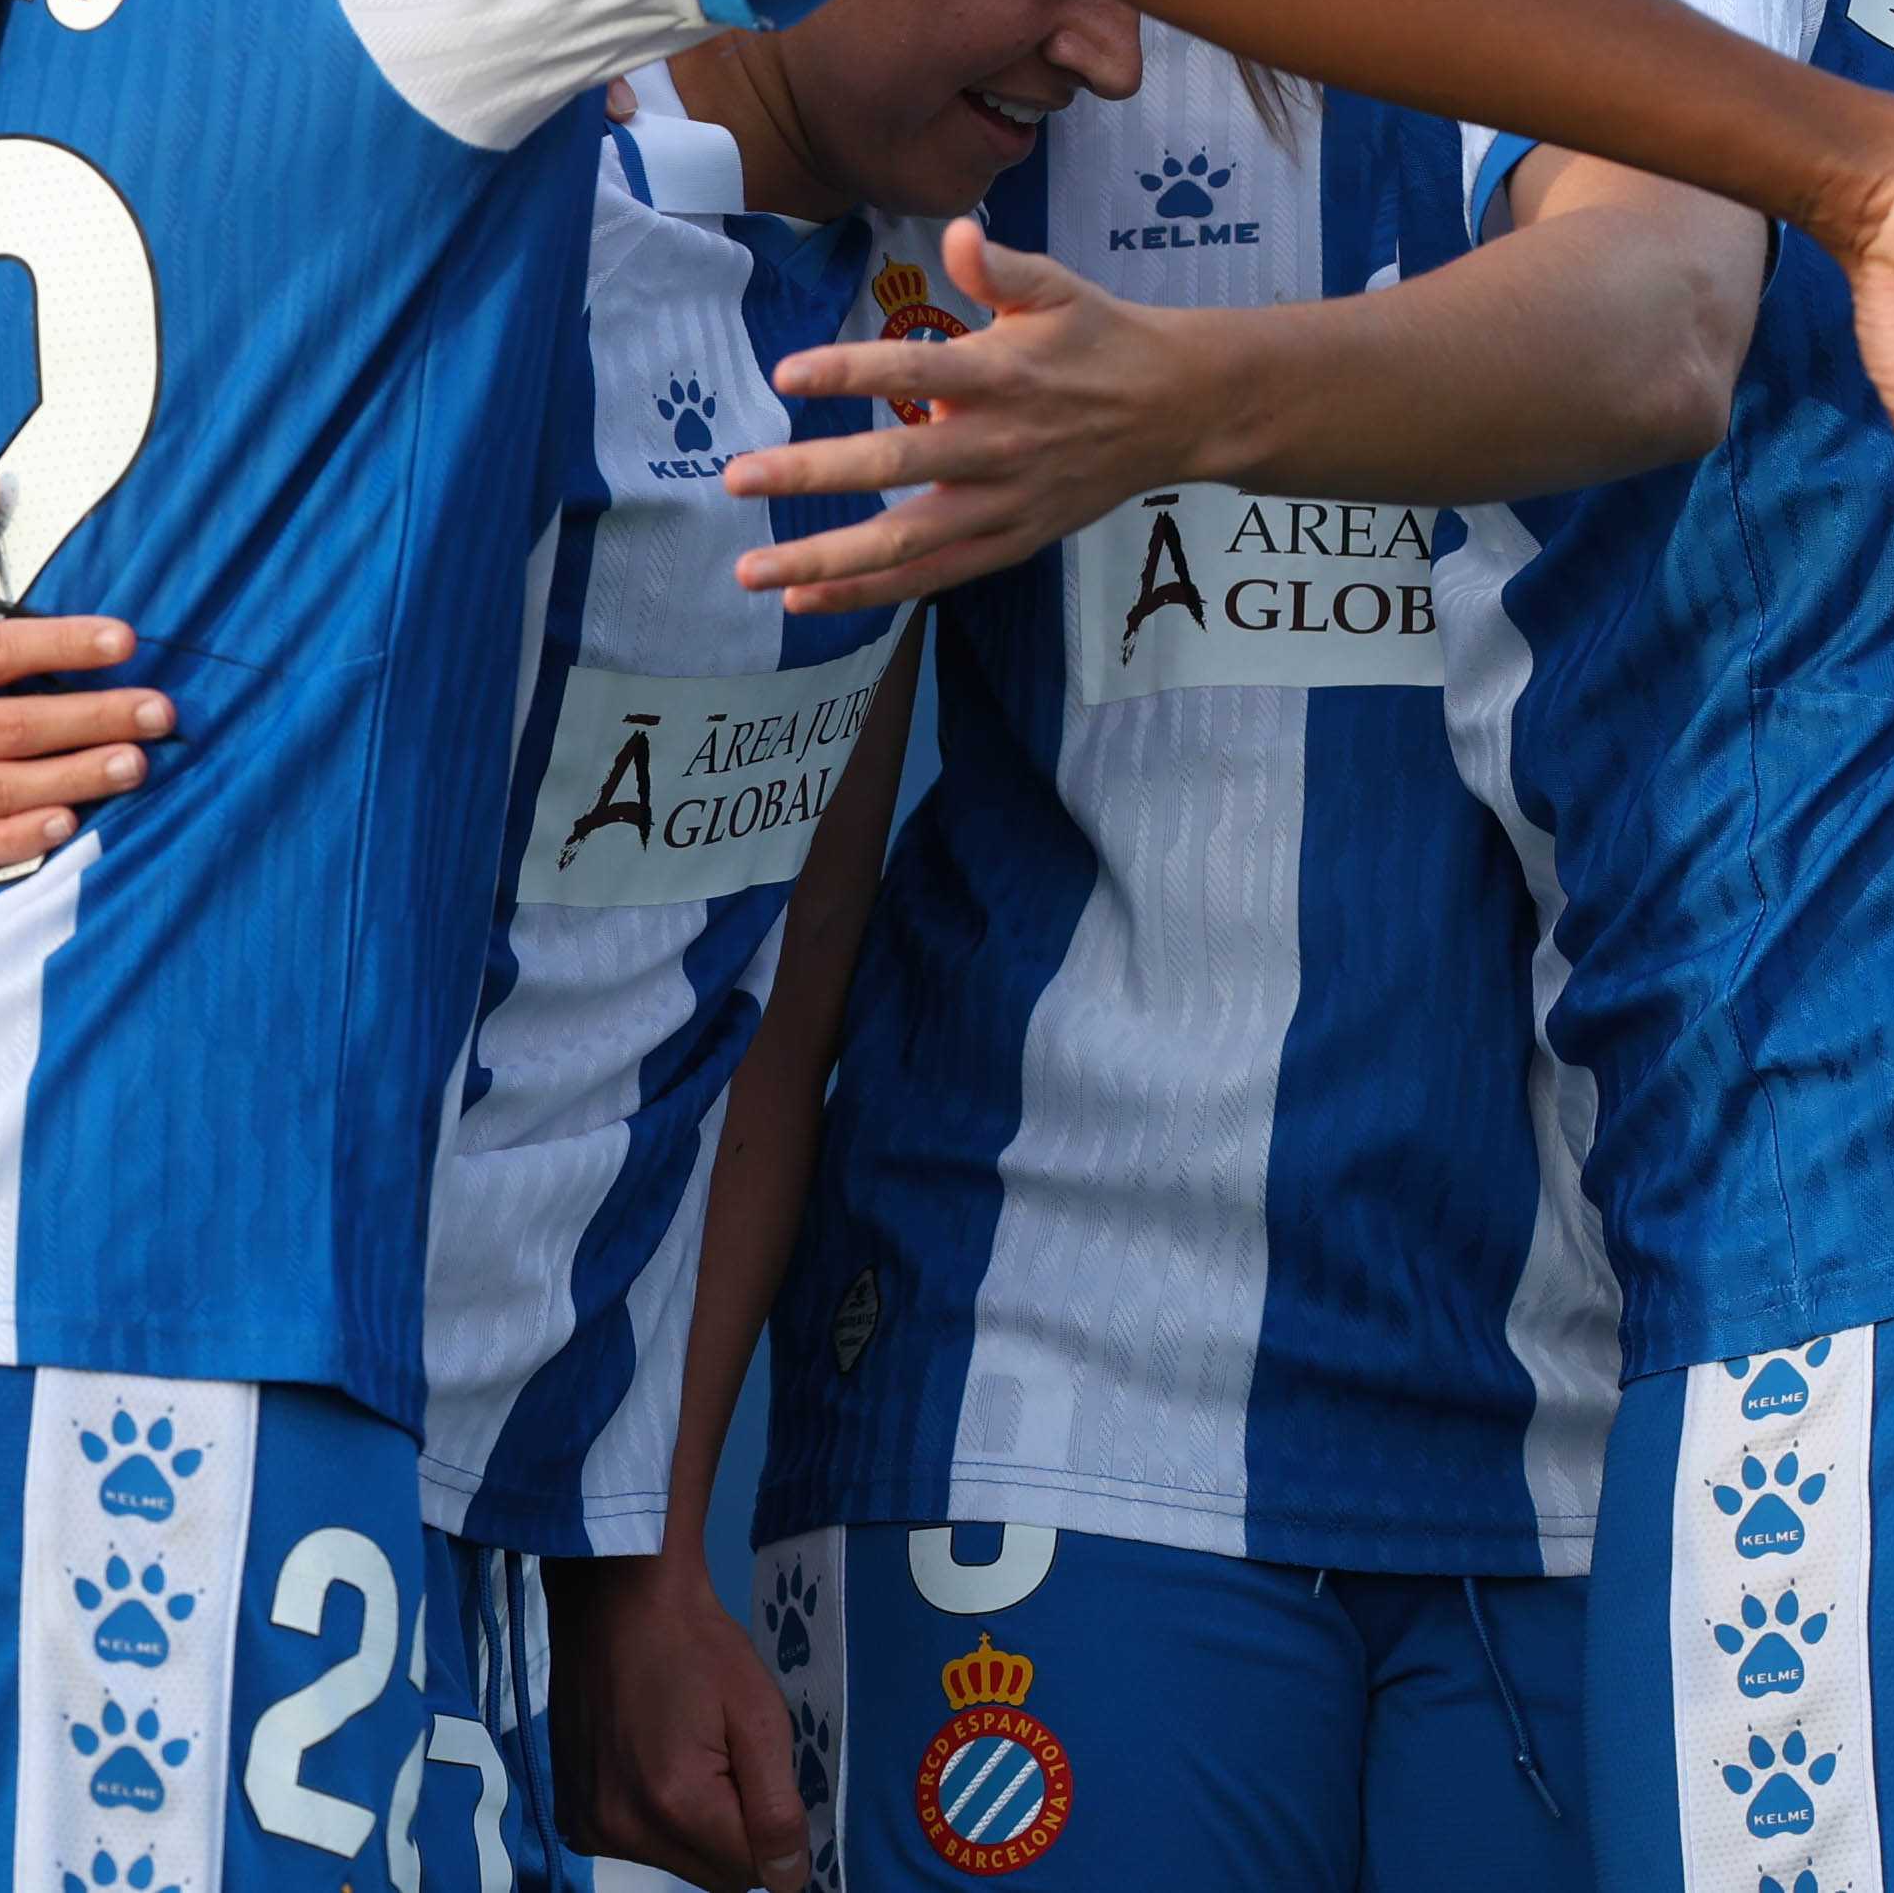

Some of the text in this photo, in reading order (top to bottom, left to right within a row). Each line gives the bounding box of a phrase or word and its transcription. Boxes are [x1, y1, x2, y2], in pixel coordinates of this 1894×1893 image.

[1110, 222, 1261, 252] KELME
[890, 307, 967, 337] ESPANYO
[1224, 578, 1437, 635] GLOB
[662, 767, 833, 849] GLOBAL
[1747, 1391, 1805, 1411] KELME
[1742, 1529, 1800, 1547] KELME
[1744, 1668, 1801, 1686] KELME
[919, 1711, 1066, 1786] RCD ESPANYOL
[921, 1795, 1069, 1870] DE BARCELONA
[1753, 1809, 1811, 1826] KELME
